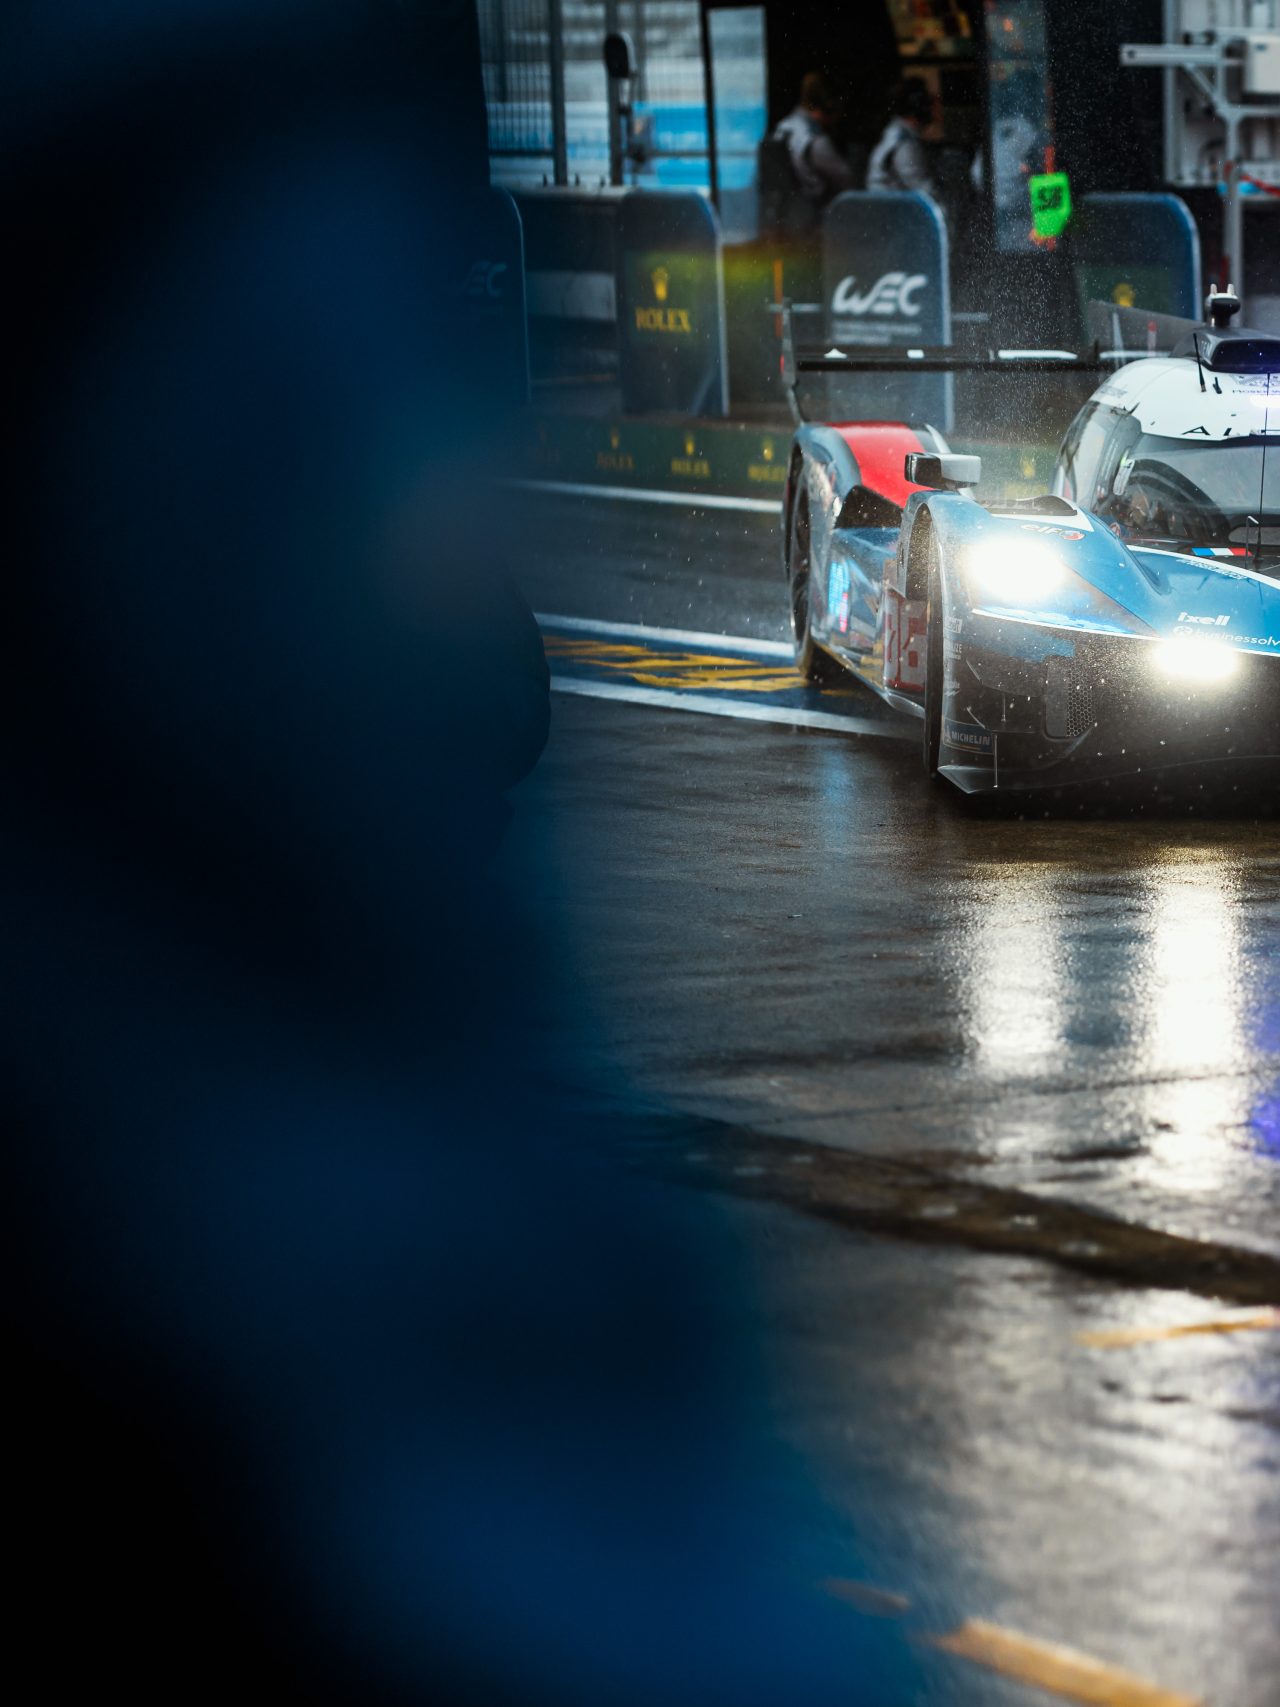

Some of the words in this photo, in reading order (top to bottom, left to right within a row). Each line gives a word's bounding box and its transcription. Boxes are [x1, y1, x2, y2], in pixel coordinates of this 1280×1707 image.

[833, 272, 928, 316] WEC
[636, 307, 692, 332] ROLEX
[951, 730, 991, 746] MICHELIN
